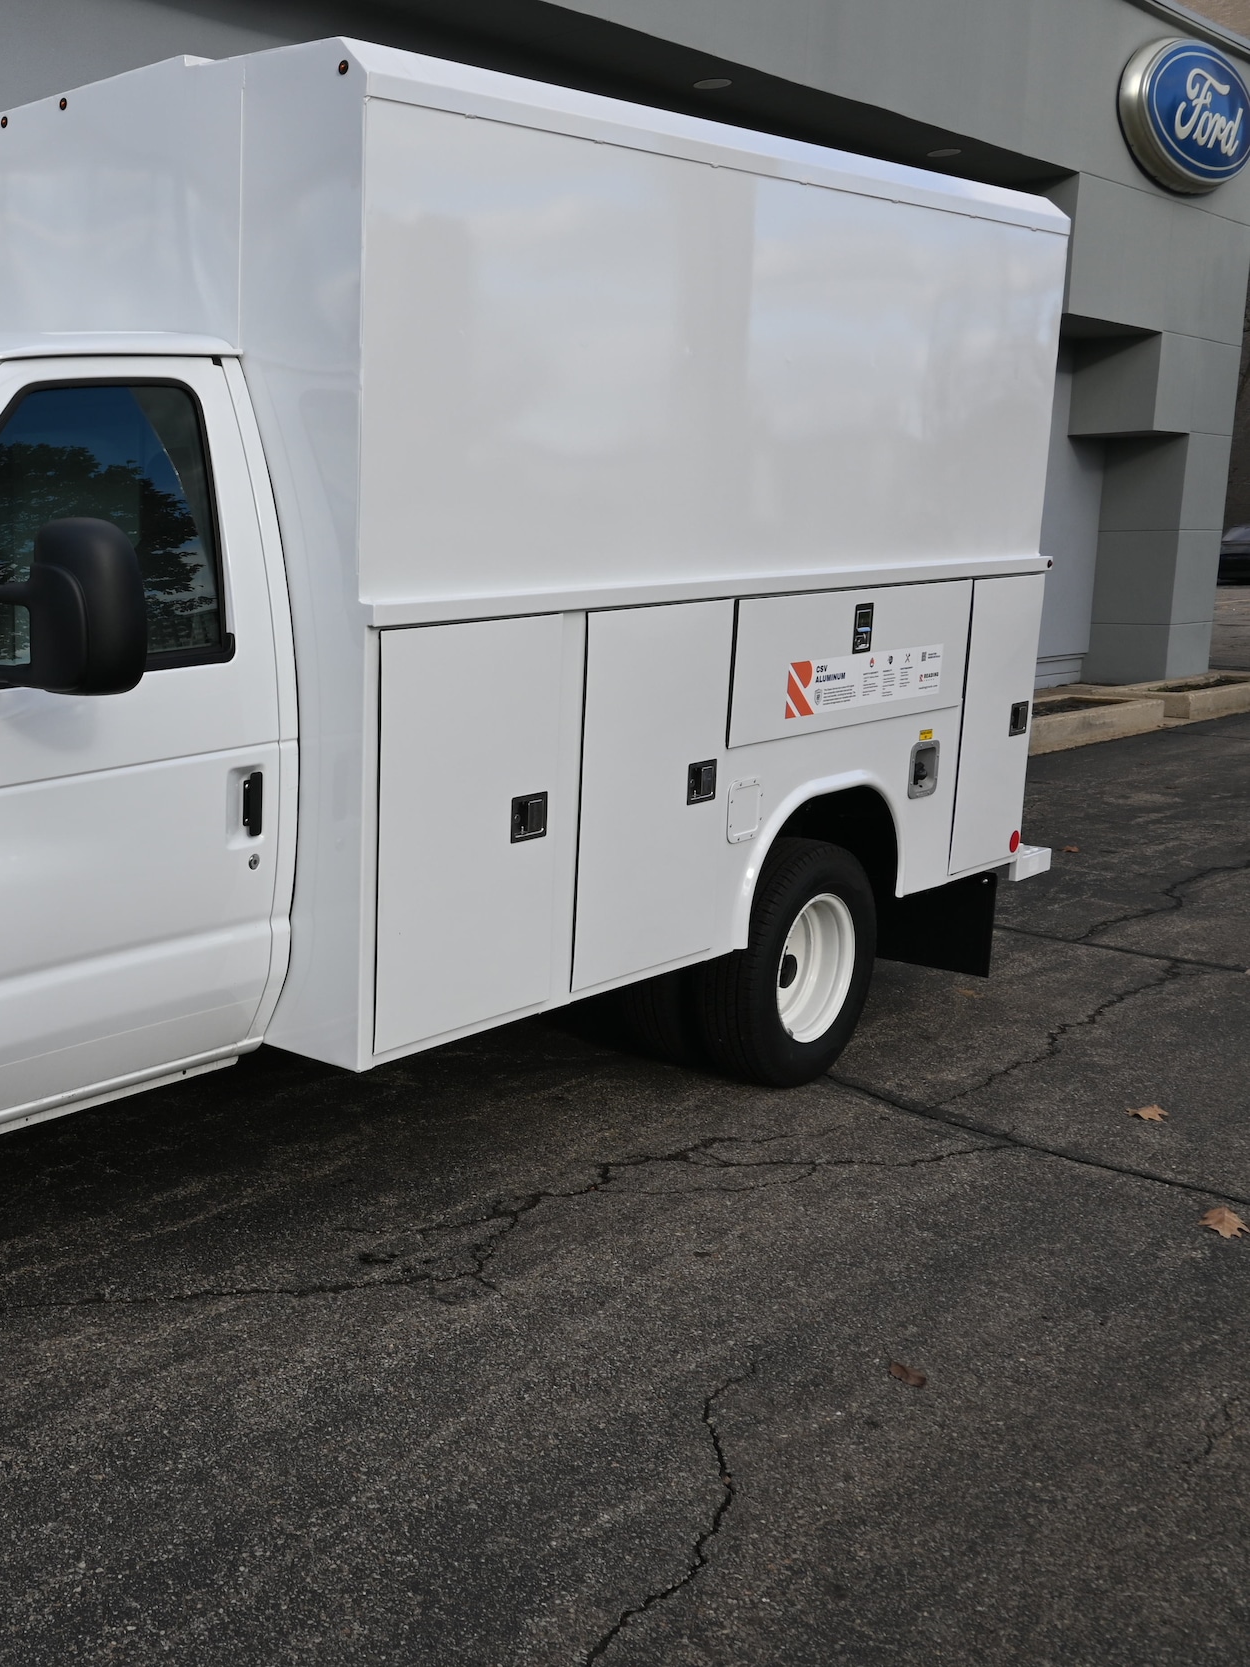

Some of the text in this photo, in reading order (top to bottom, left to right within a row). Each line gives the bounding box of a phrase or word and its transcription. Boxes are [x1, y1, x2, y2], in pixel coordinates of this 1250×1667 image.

[1175, 68, 1243, 156] Ford
[816, 664, 828, 673] CSV
[815, 672, 846, 683] ALUMINUM
